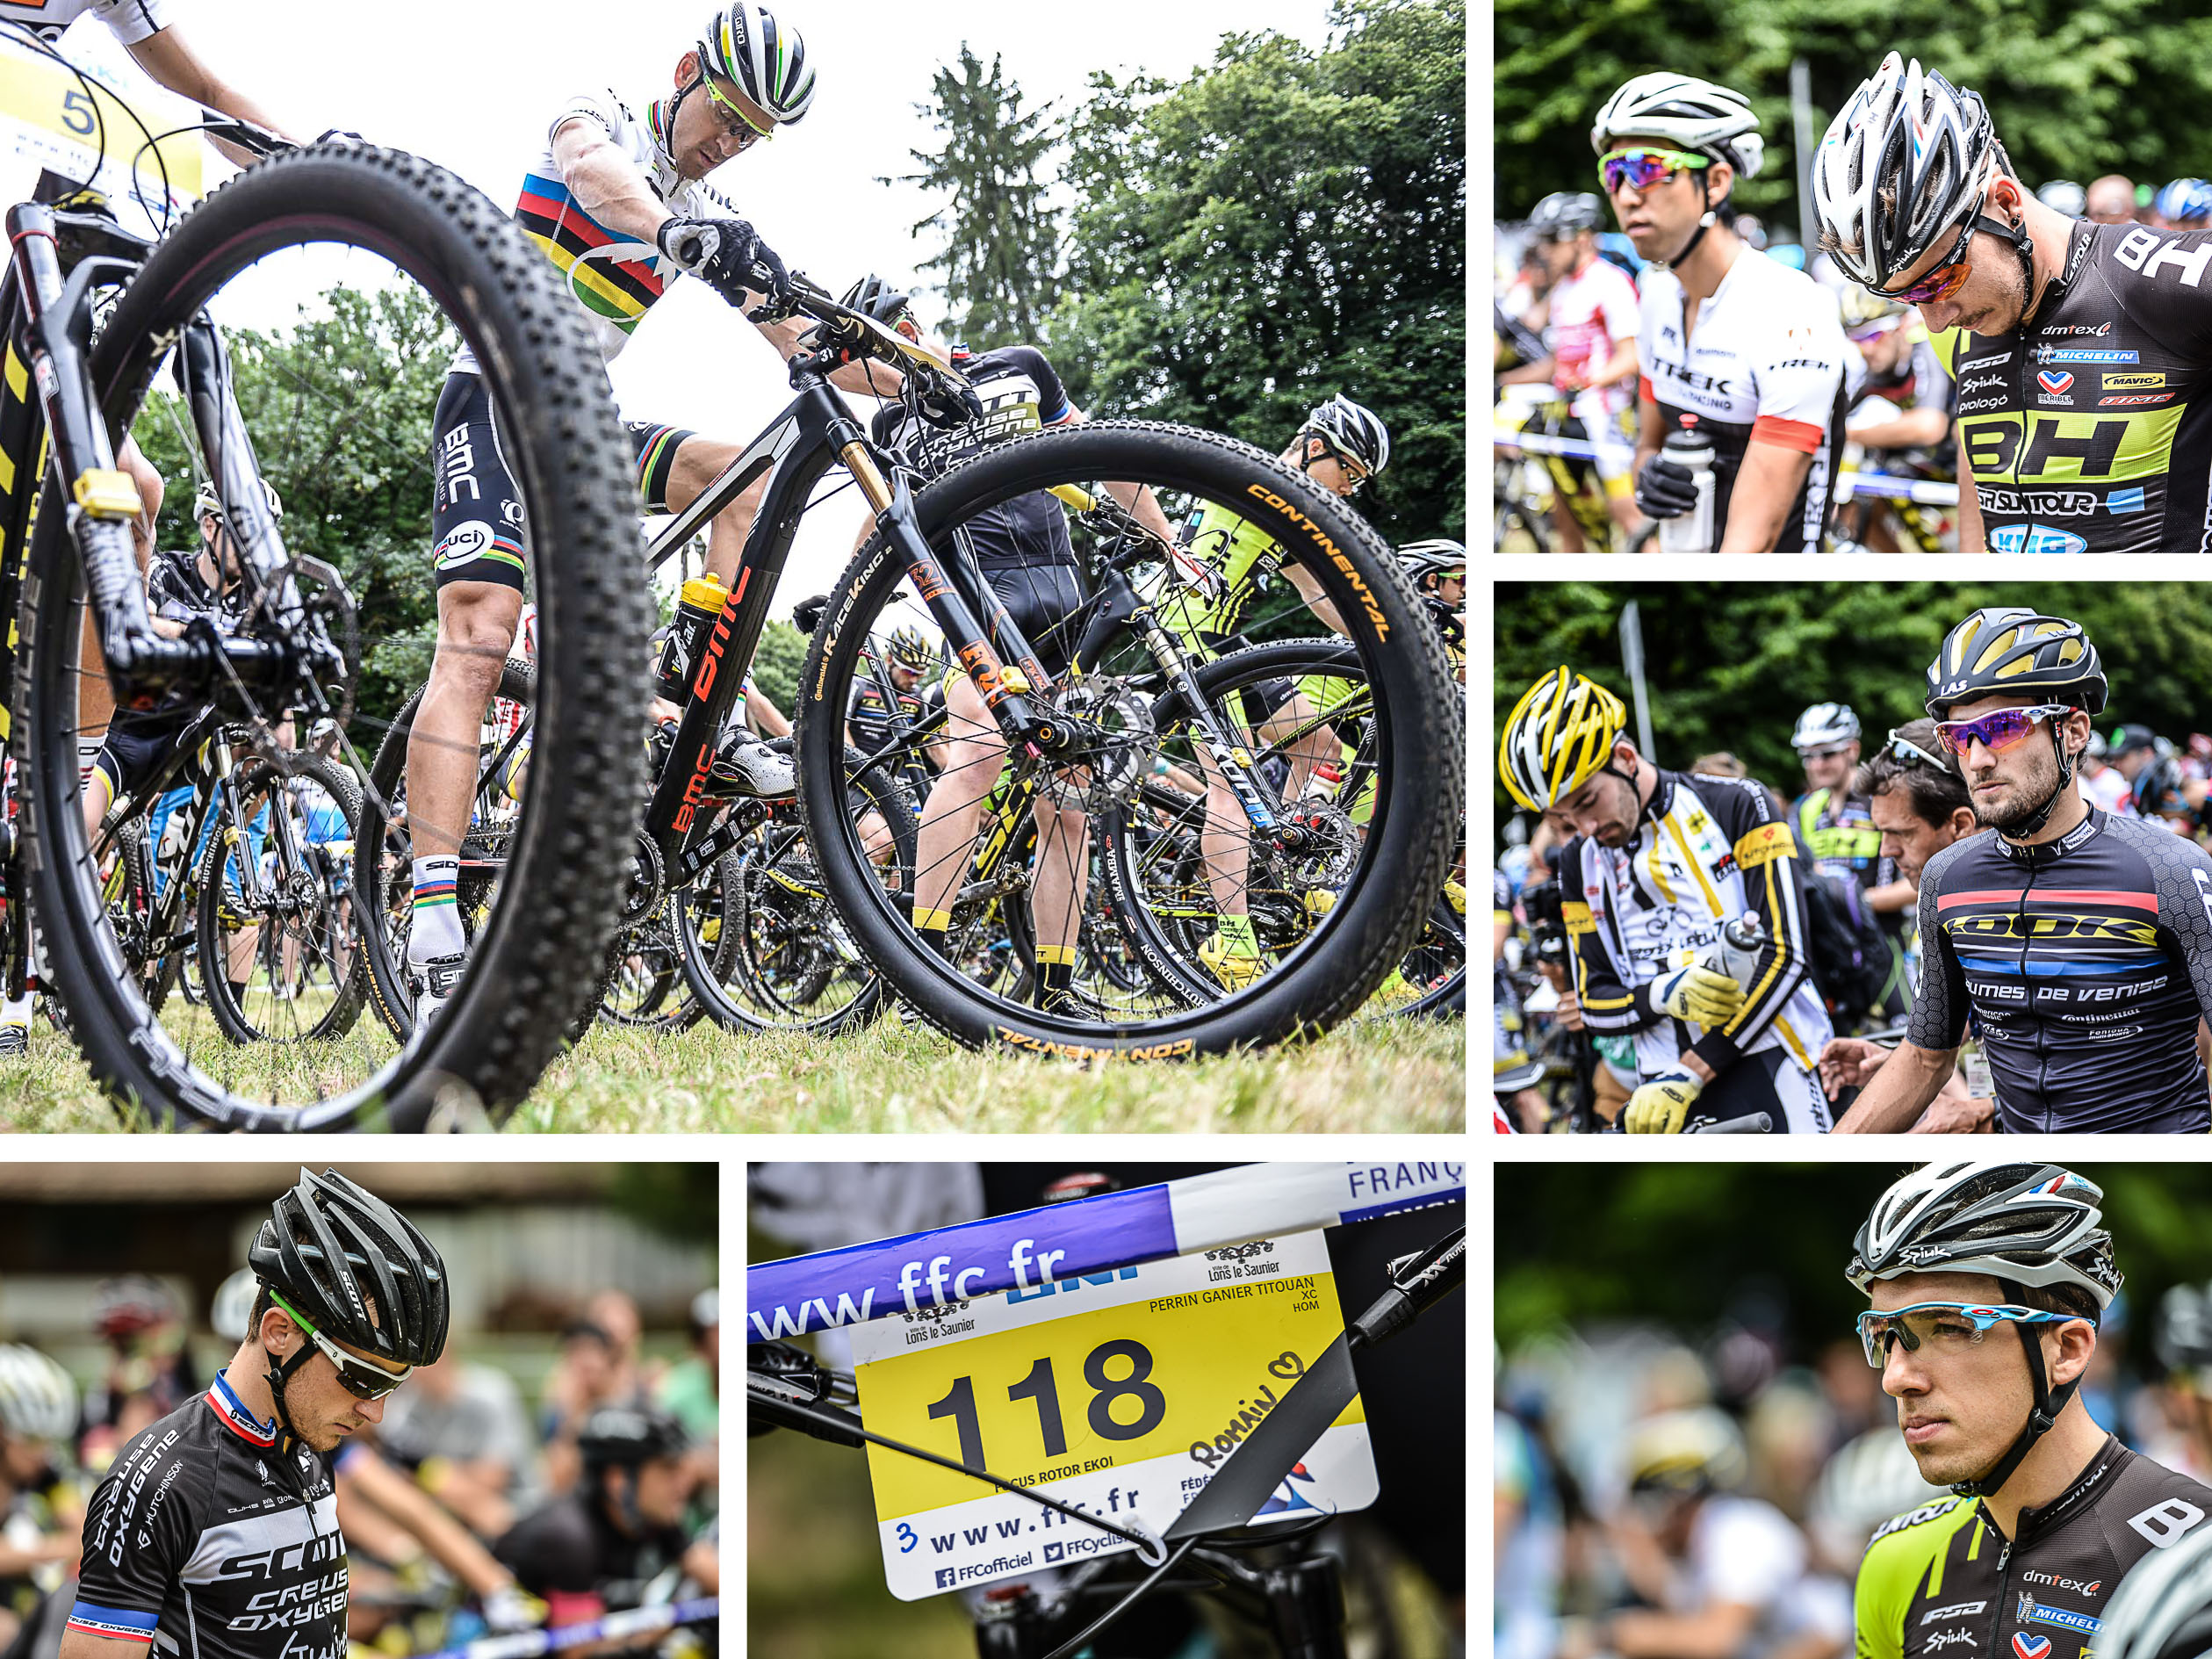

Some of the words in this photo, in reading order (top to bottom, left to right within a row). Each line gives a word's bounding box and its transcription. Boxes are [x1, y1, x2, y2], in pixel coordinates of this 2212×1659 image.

[735, 17, 746, 45] GIRO
[61, 90, 95, 135] 5
[1888, 246, 1921, 278] Spiuk
[2113, 227, 2212, 288] BH
[2041, 324, 2098, 336] dmtex
[2055, 350, 2135, 361] MICHELIN
[1652, 357, 1732, 396] TREK
[1960, 373, 2008, 396] Spiuk
[2113, 376, 2154, 386] MAVIC
[2102, 394, 2172, 405] TIME
[1963, 419, 2130, 476] BH
[444, 422, 480, 504] BMC
[1997, 492, 2094, 515] SUNTOUR
[1247, 484, 1390, 644] CONTINENTAL
[1940, 679, 1969, 696] LAS
[671, 743, 717, 834] BMC
[202, 823, 225, 884] HUTCHINSON
[1945, 914, 2156, 947] LOOK
[360, 935, 402, 1034] CONTINENTAL
[1898, 1244, 1952, 1266] Spiuk
[1208, 1266, 1231, 1282] Lons
[1233, 1265, 1243, 1279] le
[1243, 1259, 1281, 1277] Saunier
[2086, 1256, 2124, 1294] Spiuk
[338, 1270, 367, 1322] SCOTT
[1149, 1294, 1198, 1314] PERRIN
[1202, 1285, 1253, 1304] GANIER
[1255, 1276, 1315, 1296] TITOUAN
[1293, 1300, 1321, 1314] HOM
[1301, 1289, 1318, 1302] XC
[905, 1331, 928, 1345] Lons
[929, 1326, 939, 1339] le
[940, 1318, 976, 1337] Saunier
[926, 1338, 1167, 1476] 118
[1039, 1464, 1082, 1484] ROTOR
[1084, 1456, 1114, 1474] EKOI
[1180, 1474, 1214, 1492] FÉDÉ
[145, 1461, 184, 1526] HUTCHINSON
[277, 1495, 295, 1504] KON
[896, 1522, 919, 1554] 3
[958, 1551, 1034, 1582] FFCofficiel
[2022, 1569, 2084, 1591] dmtex
[1922, 1627, 1978, 1655] Spiuk
